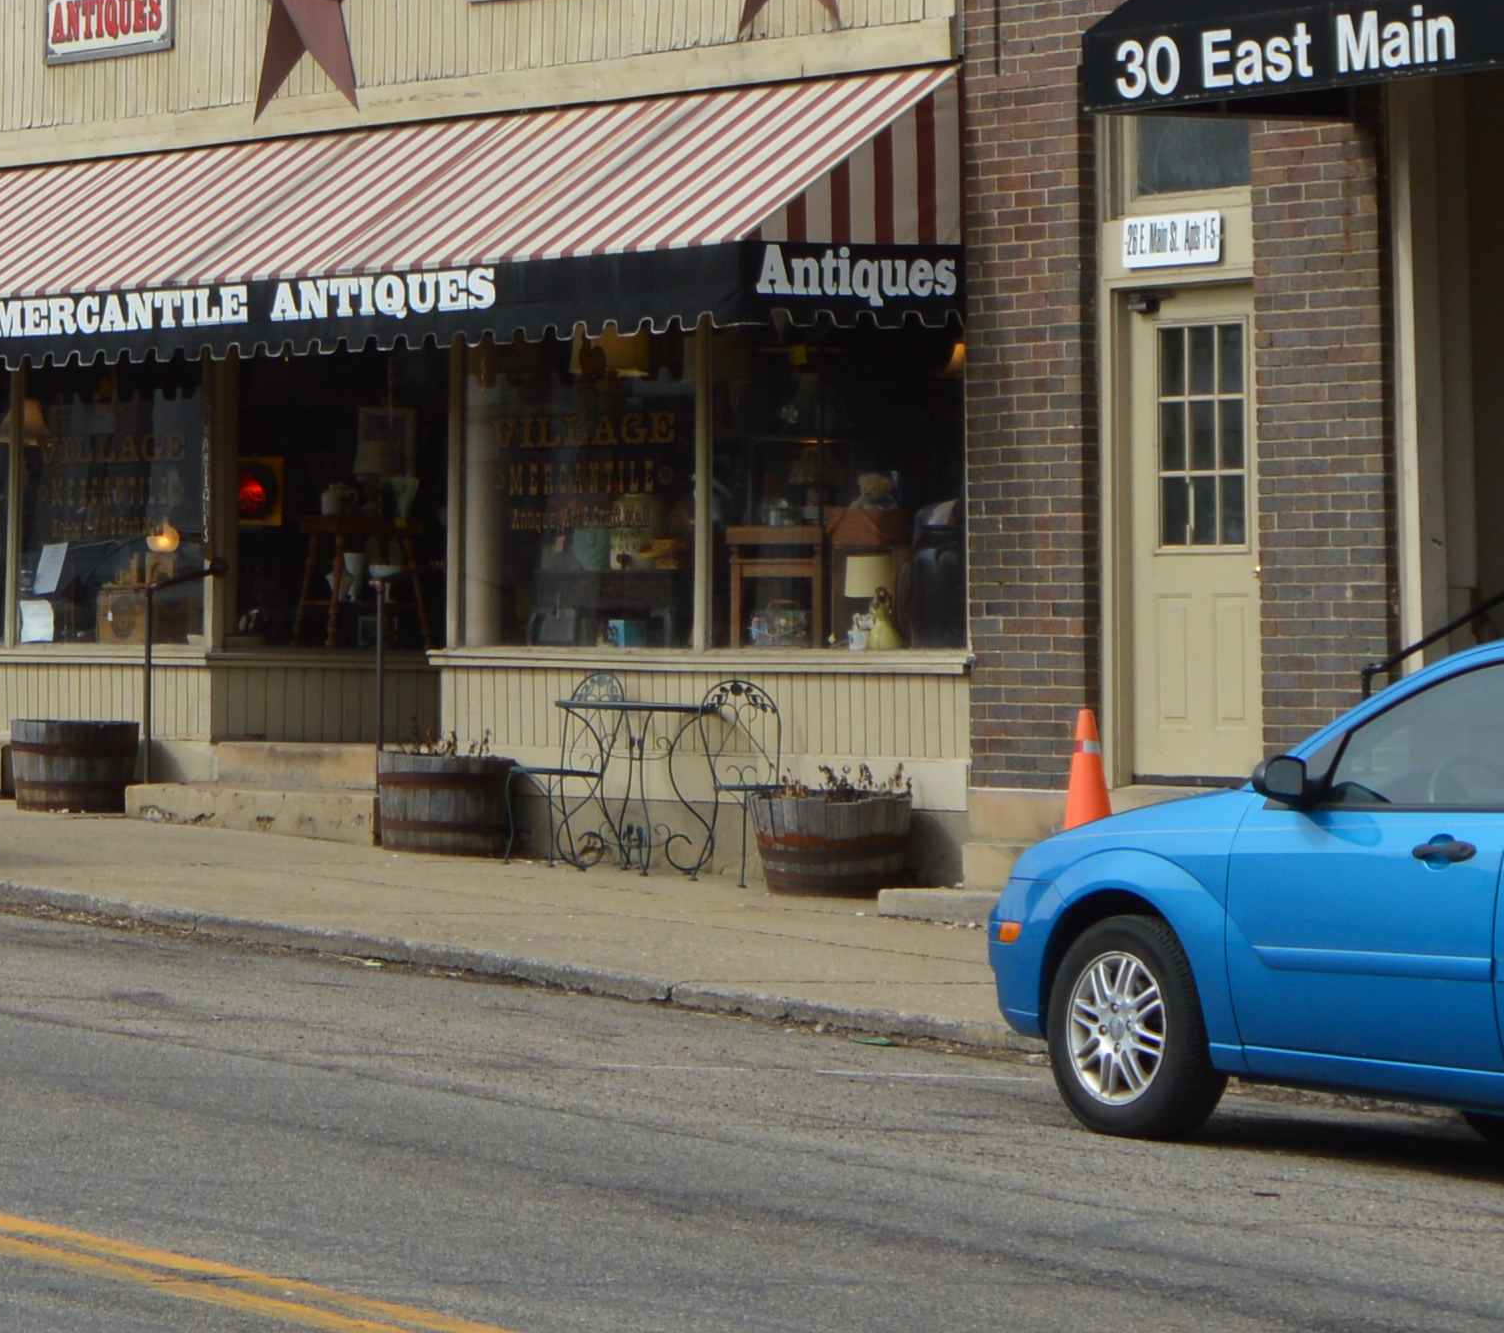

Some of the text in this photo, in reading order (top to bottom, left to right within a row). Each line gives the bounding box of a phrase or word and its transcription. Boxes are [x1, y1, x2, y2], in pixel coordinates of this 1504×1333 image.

[1115, 5, 1457, 100] 30 East Main
[270, 267, 496, 321] ANTIQUES
[755, 243, 958, 307] Antiques
[42, 433, 187, 465] VILLAGE
[492, 411, 677, 450] VILLAGE
[509, 459, 654, 496] MERCANTILE
